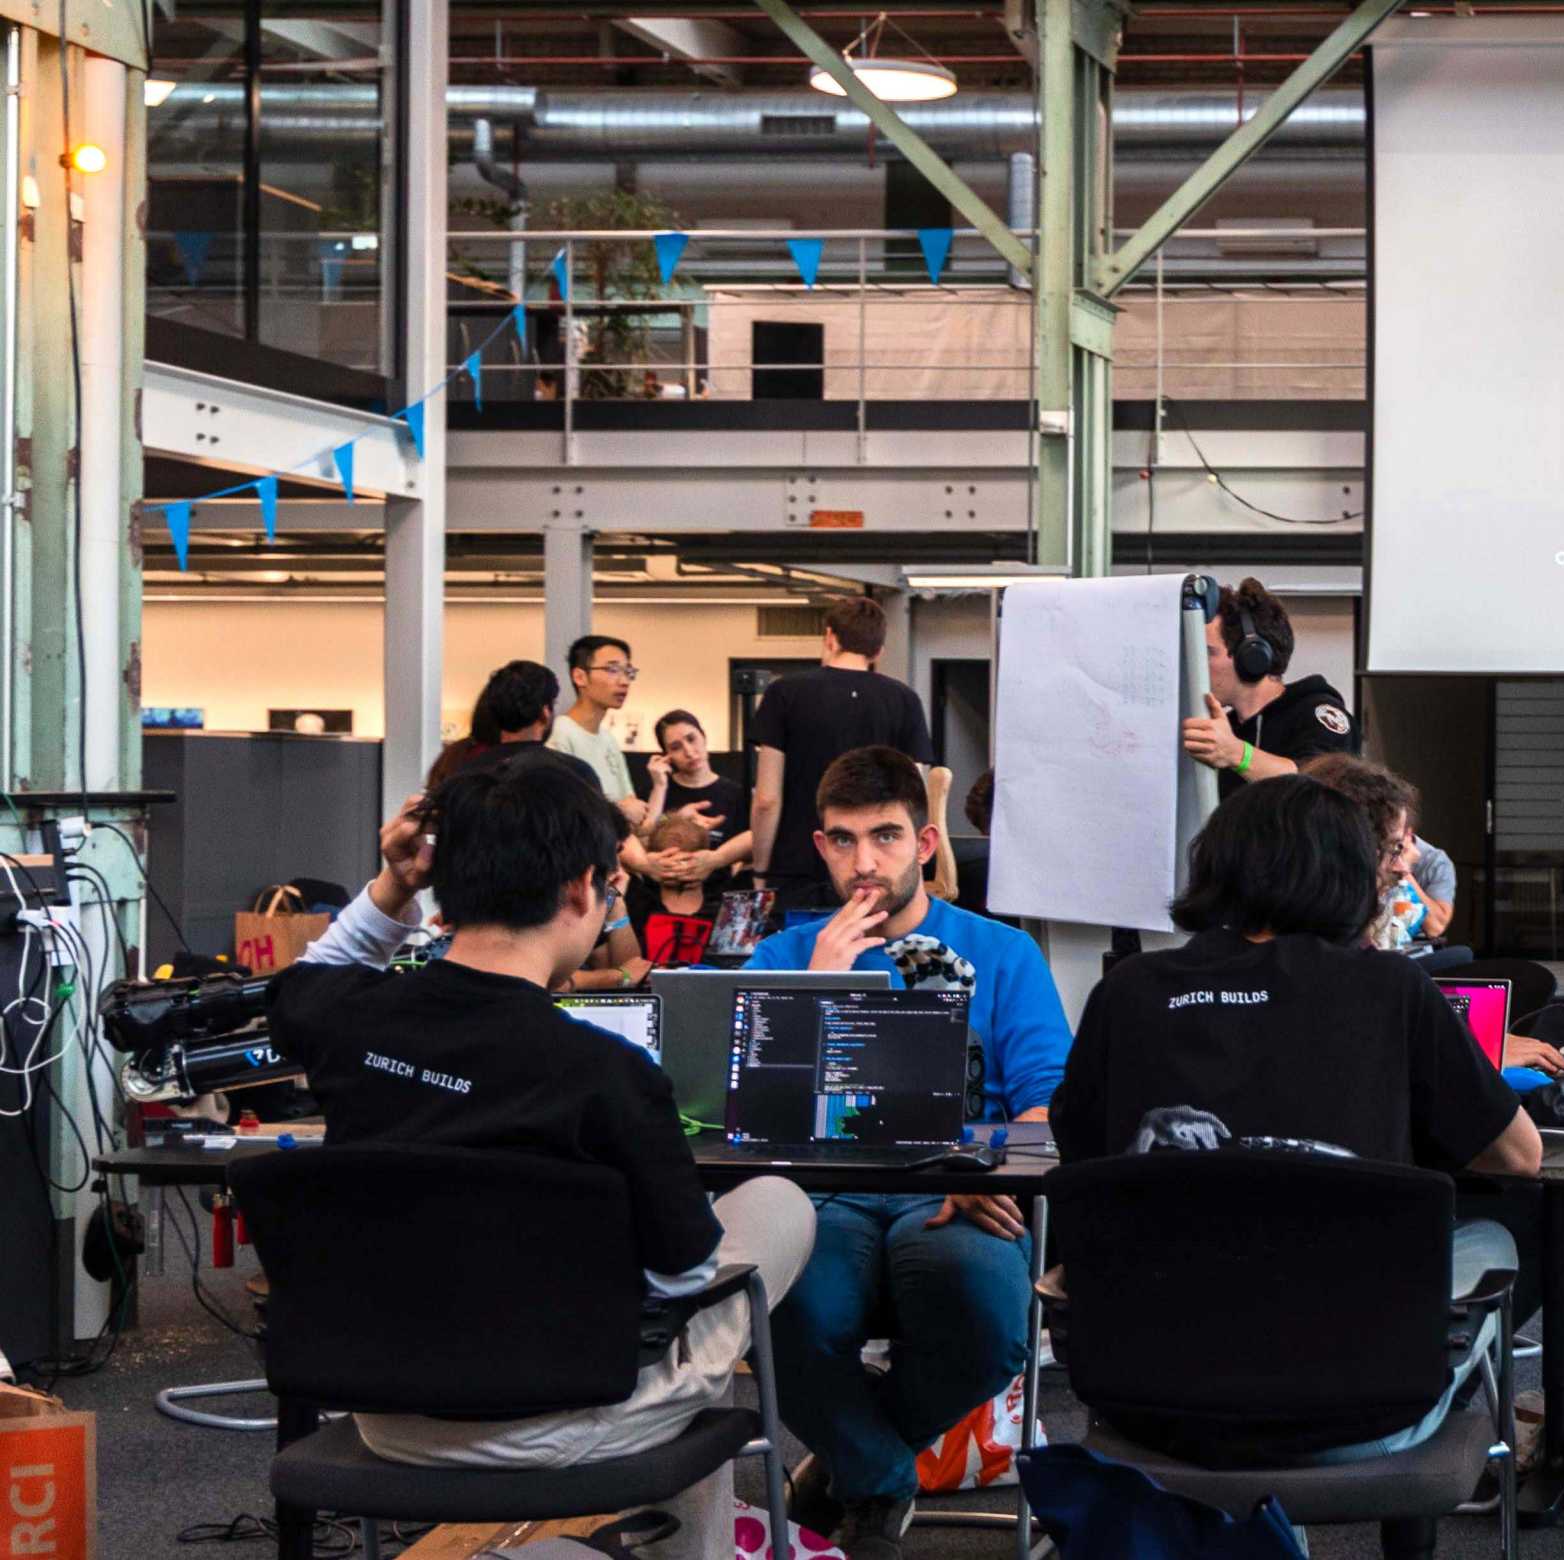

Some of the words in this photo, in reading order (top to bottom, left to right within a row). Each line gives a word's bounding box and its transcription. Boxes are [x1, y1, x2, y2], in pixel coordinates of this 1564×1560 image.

[1168, 991, 1214, 1009] ZURICH
[1221, 990, 1269, 1004] BUILDS
[364, 1051, 415, 1078] ZURICH
[422, 1069, 472, 1094] BUILDS
[10, 1463, 57, 1558] RCI
